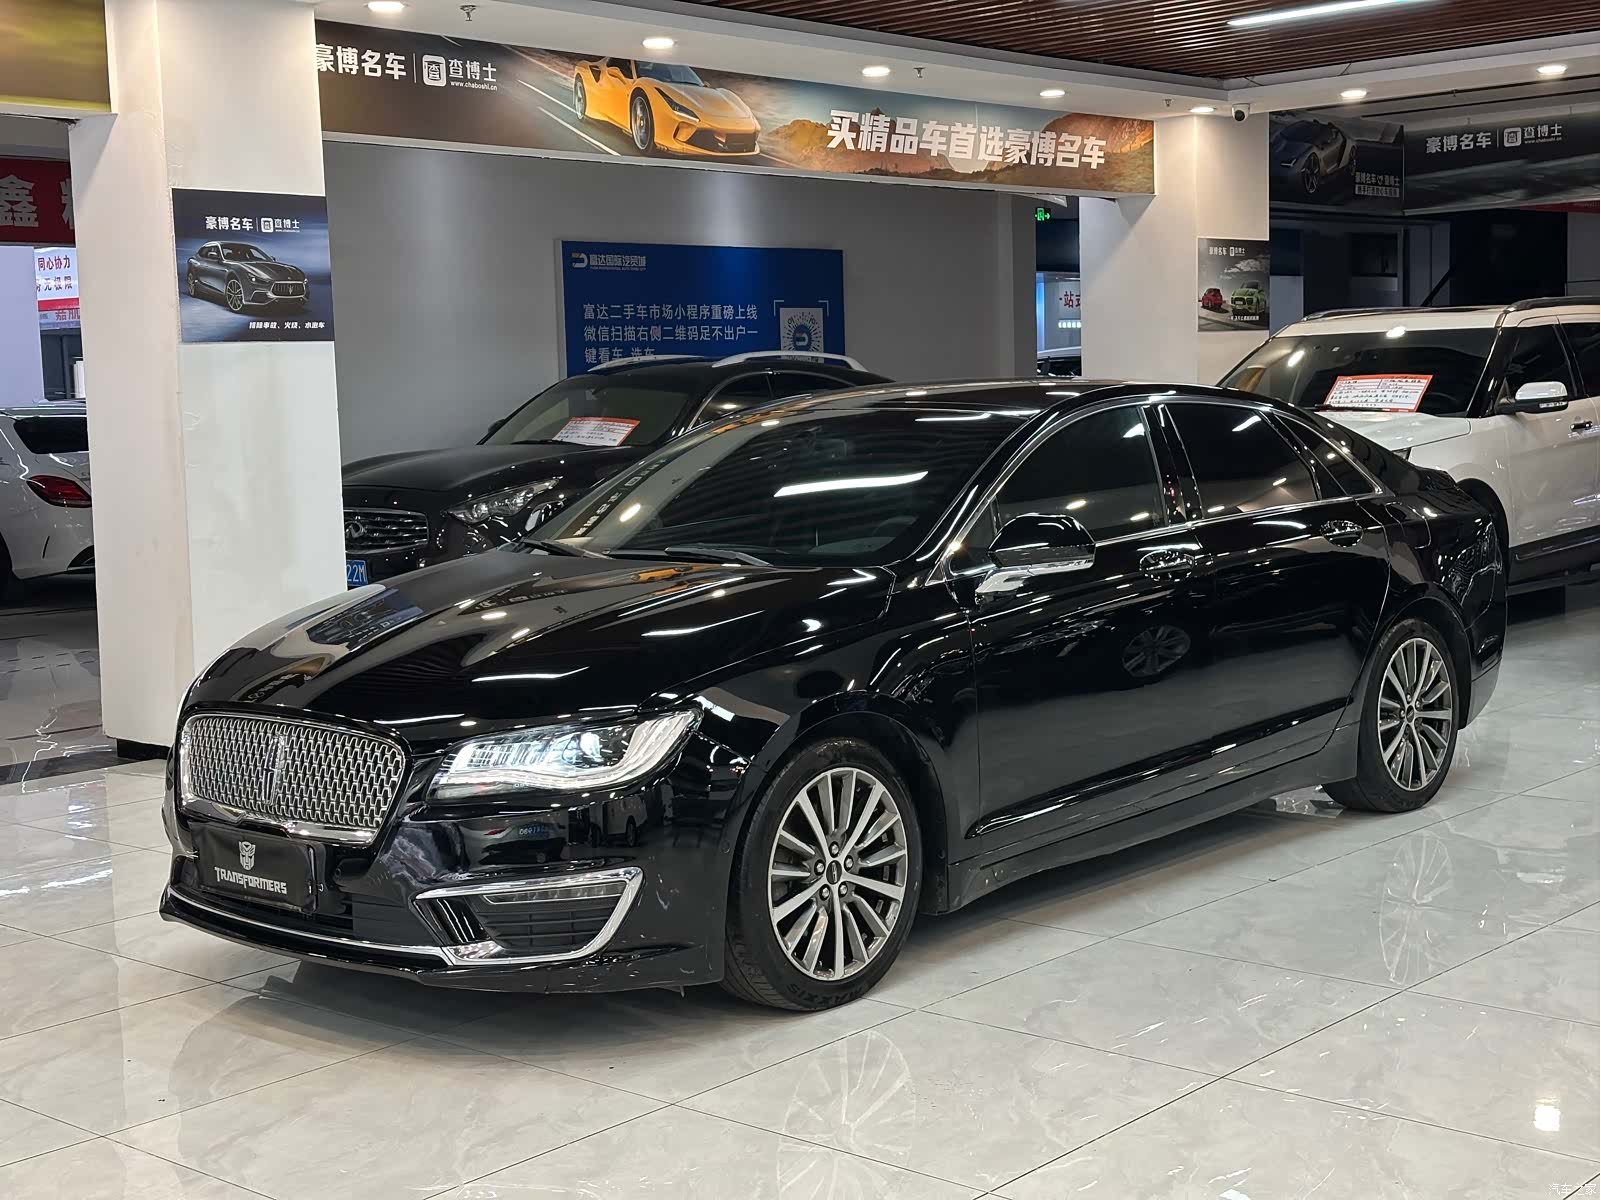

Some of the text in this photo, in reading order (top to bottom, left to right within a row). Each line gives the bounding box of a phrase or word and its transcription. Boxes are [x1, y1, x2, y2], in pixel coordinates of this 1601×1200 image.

[315, 43, 406, 80] 豪博名车
[448, 58, 497, 82] 查博士
[450, 81, 498, 91] www.chaboshi.cn
[827, 109, 1107, 169] 买精品车首选豪博名车
[1426, 131, 1492, 153] 豪博名车
[205, 216, 253, 231] 豪博名车
[37, 255, 71, 271] 同心协力
[583, 303, 758, 321] 富达二手车市场小程序重磅上线
[583, 325, 759, 343] 微信扫描右侧二维码足不出户一
[214, 866, 288, 895] TRANSFORMERS
